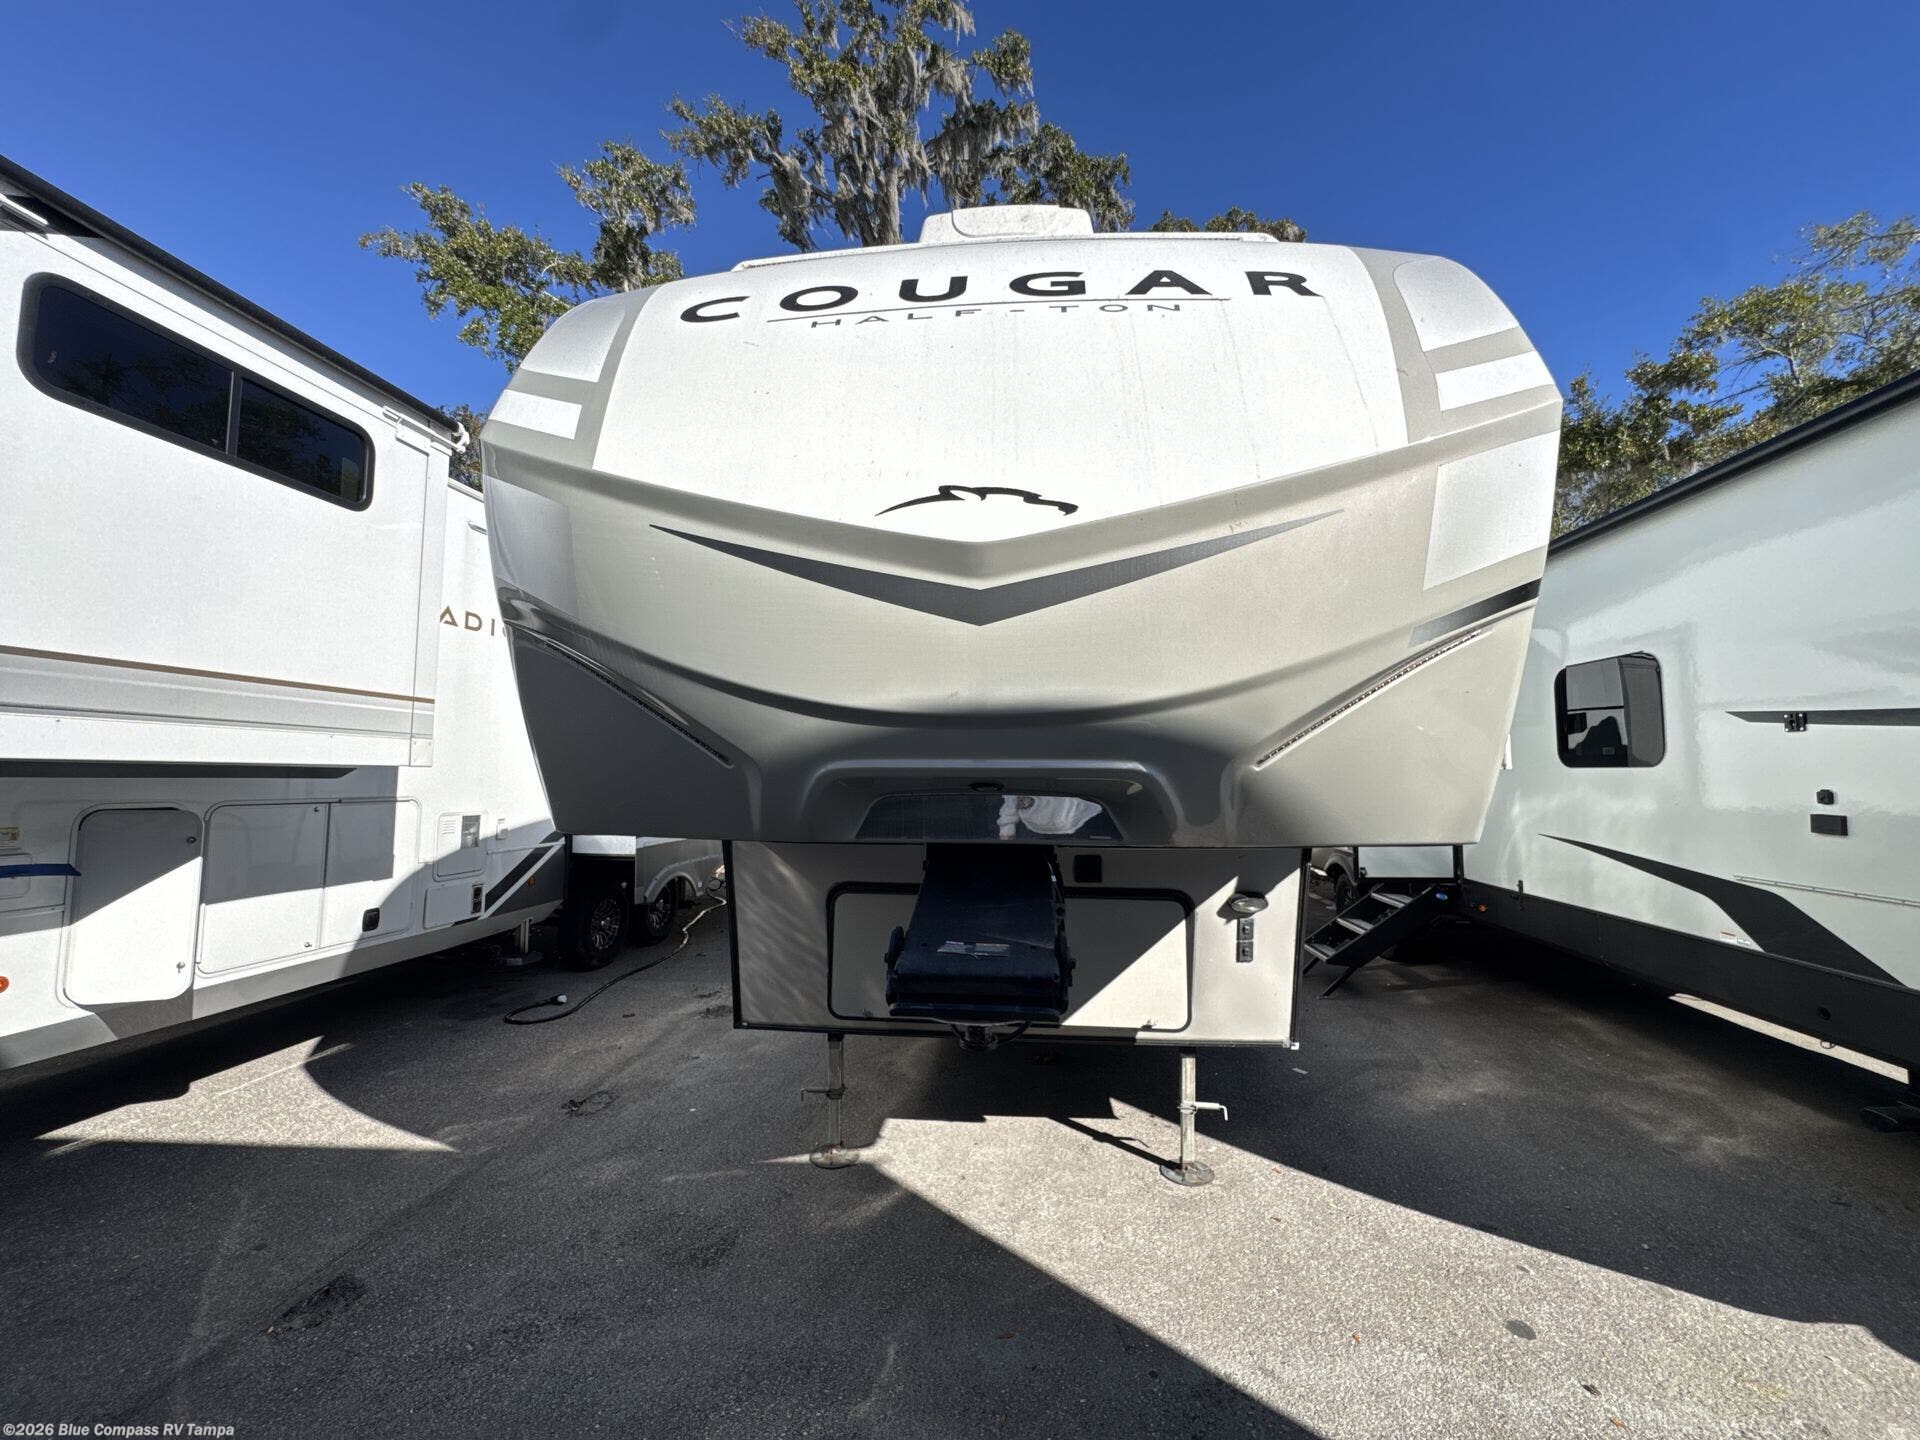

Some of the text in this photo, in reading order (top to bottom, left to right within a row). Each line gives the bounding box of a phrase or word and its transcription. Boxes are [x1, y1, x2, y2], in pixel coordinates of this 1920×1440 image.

[681, 270, 1321, 323] COUGAR
[811, 303, 1181, 328] HALF-TON
[440, 605, 507, 638] ADI
